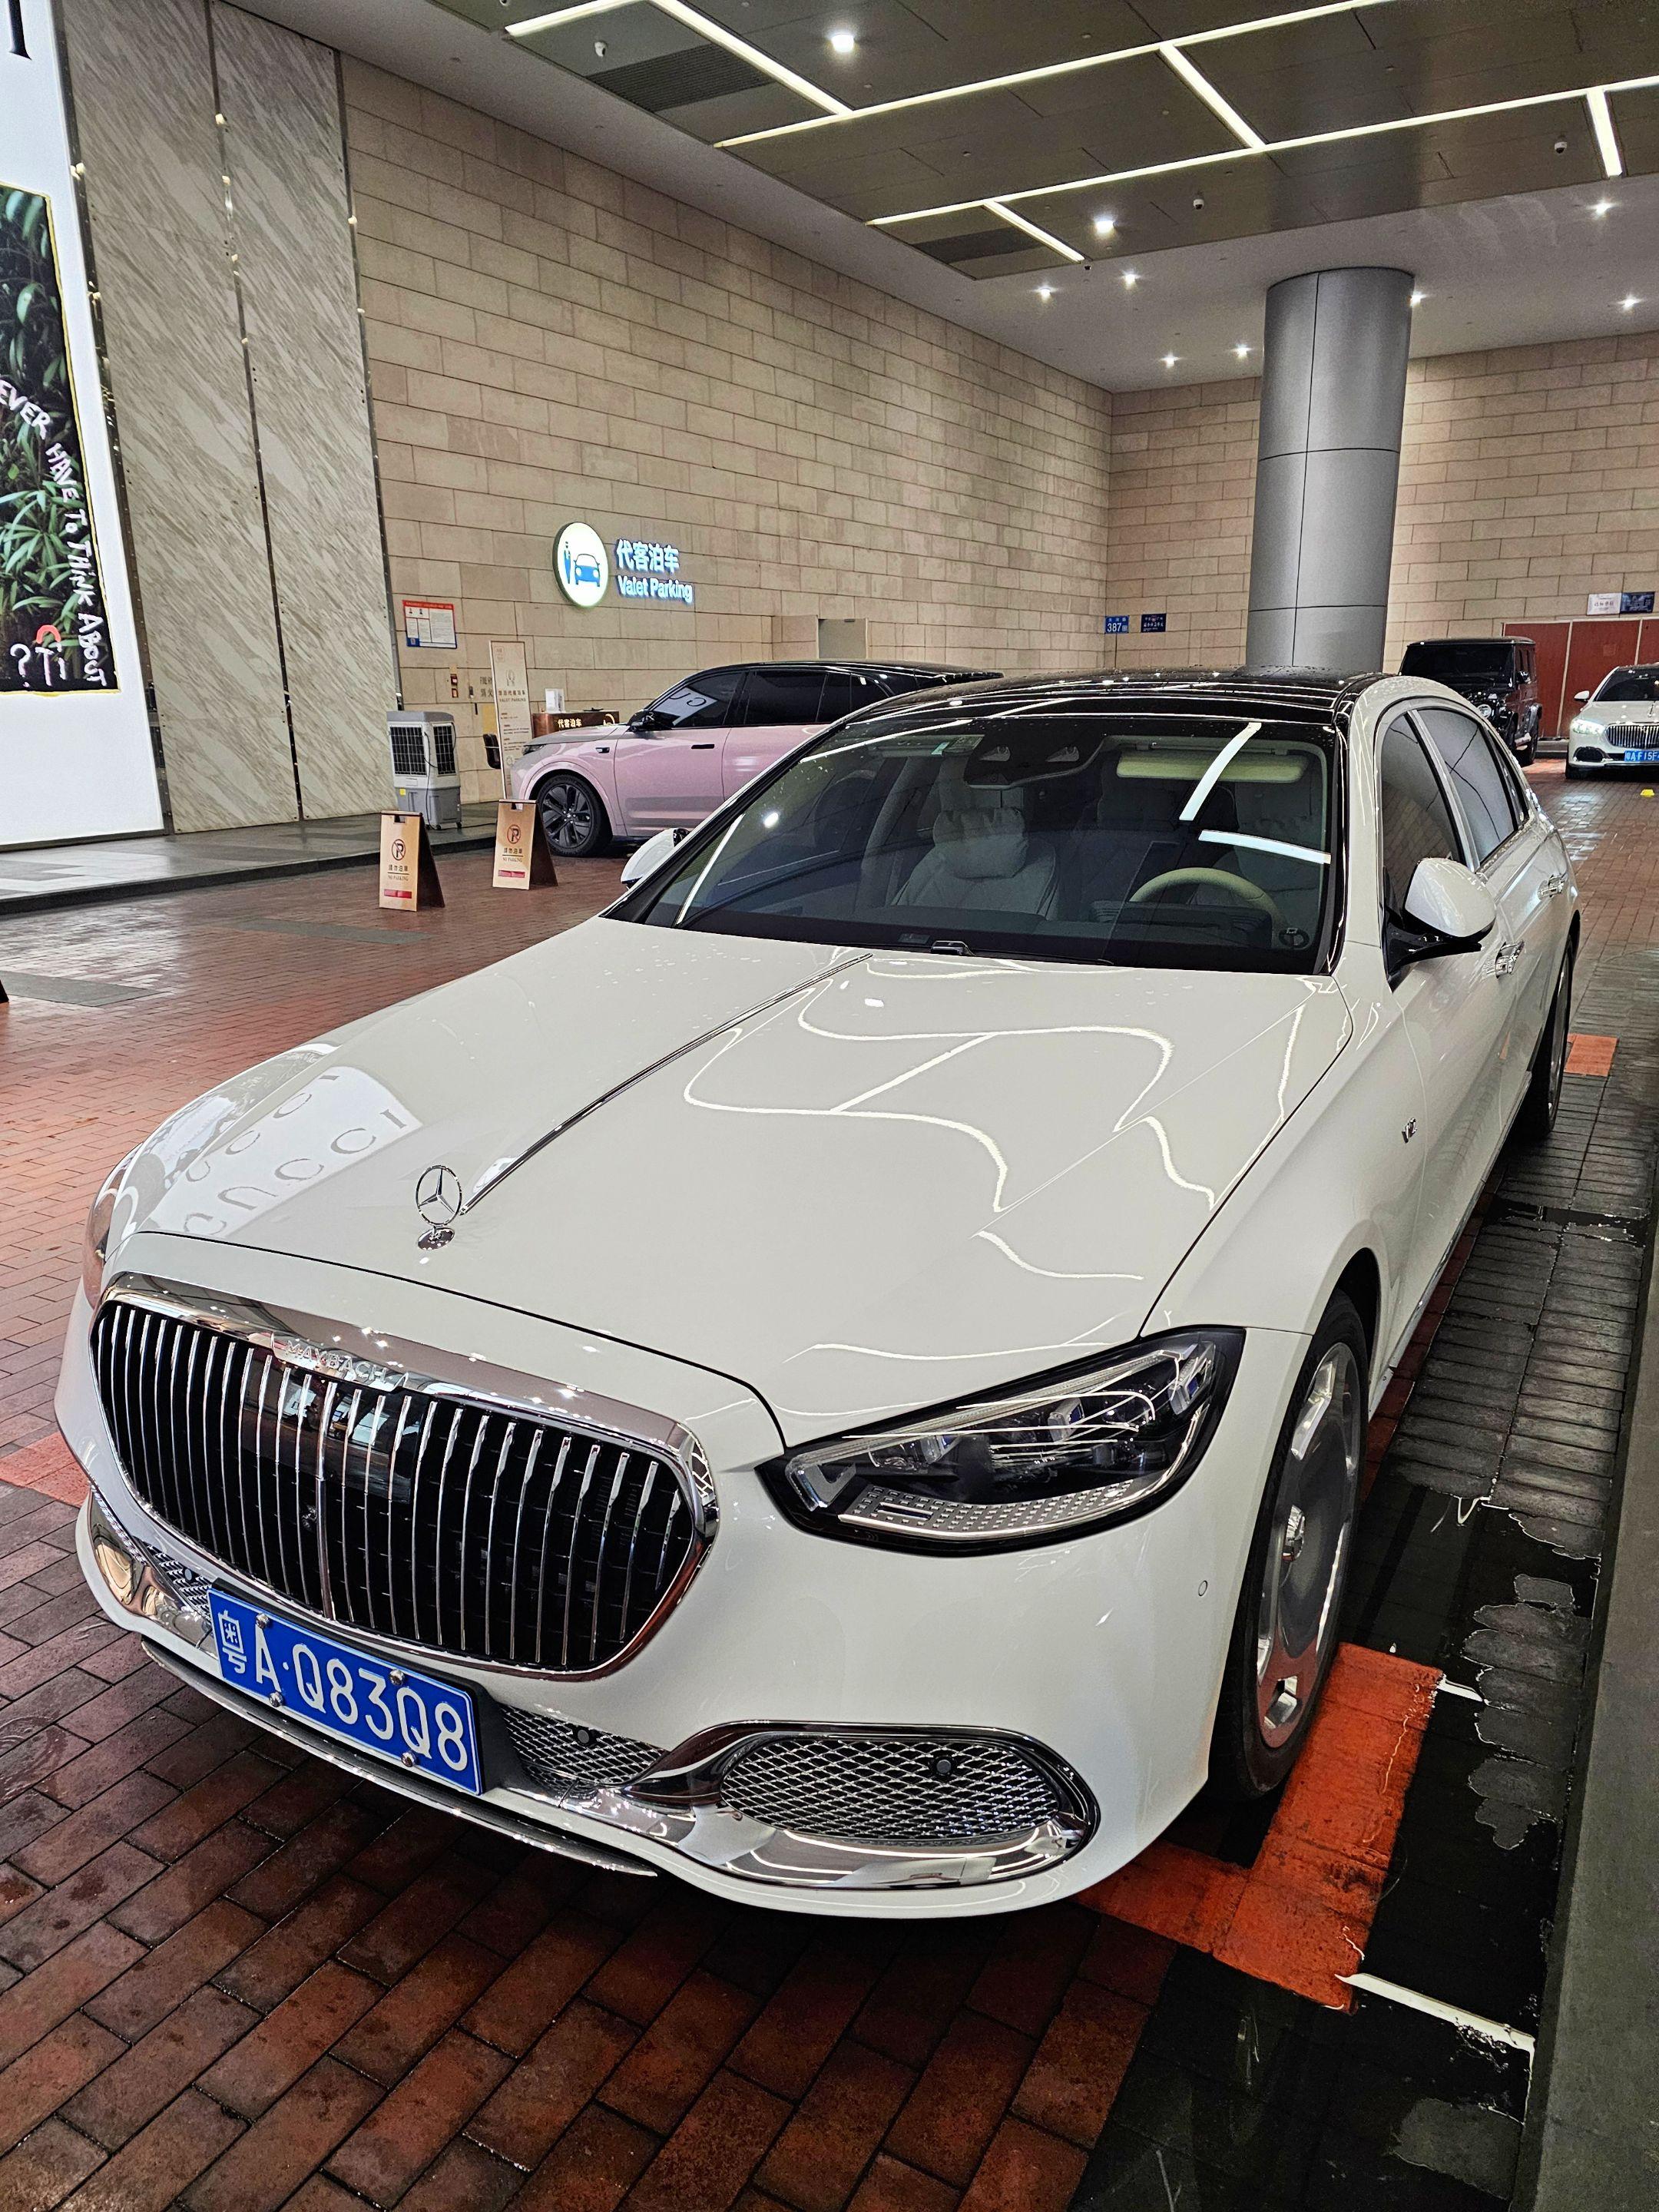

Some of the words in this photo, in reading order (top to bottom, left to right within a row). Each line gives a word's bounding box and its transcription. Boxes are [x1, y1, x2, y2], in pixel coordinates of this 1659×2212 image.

[45, 442, 80, 503] HAVE
[78, 612, 107, 687] ABOUT
[616, 538, 680, 575] 代客泊车
[618, 575, 649, 597] Valet
[650, 578, 694, 605] Parking
[1107, 622, 1122, 632] 387
[285, 1339, 387, 1382] MAYBACH
